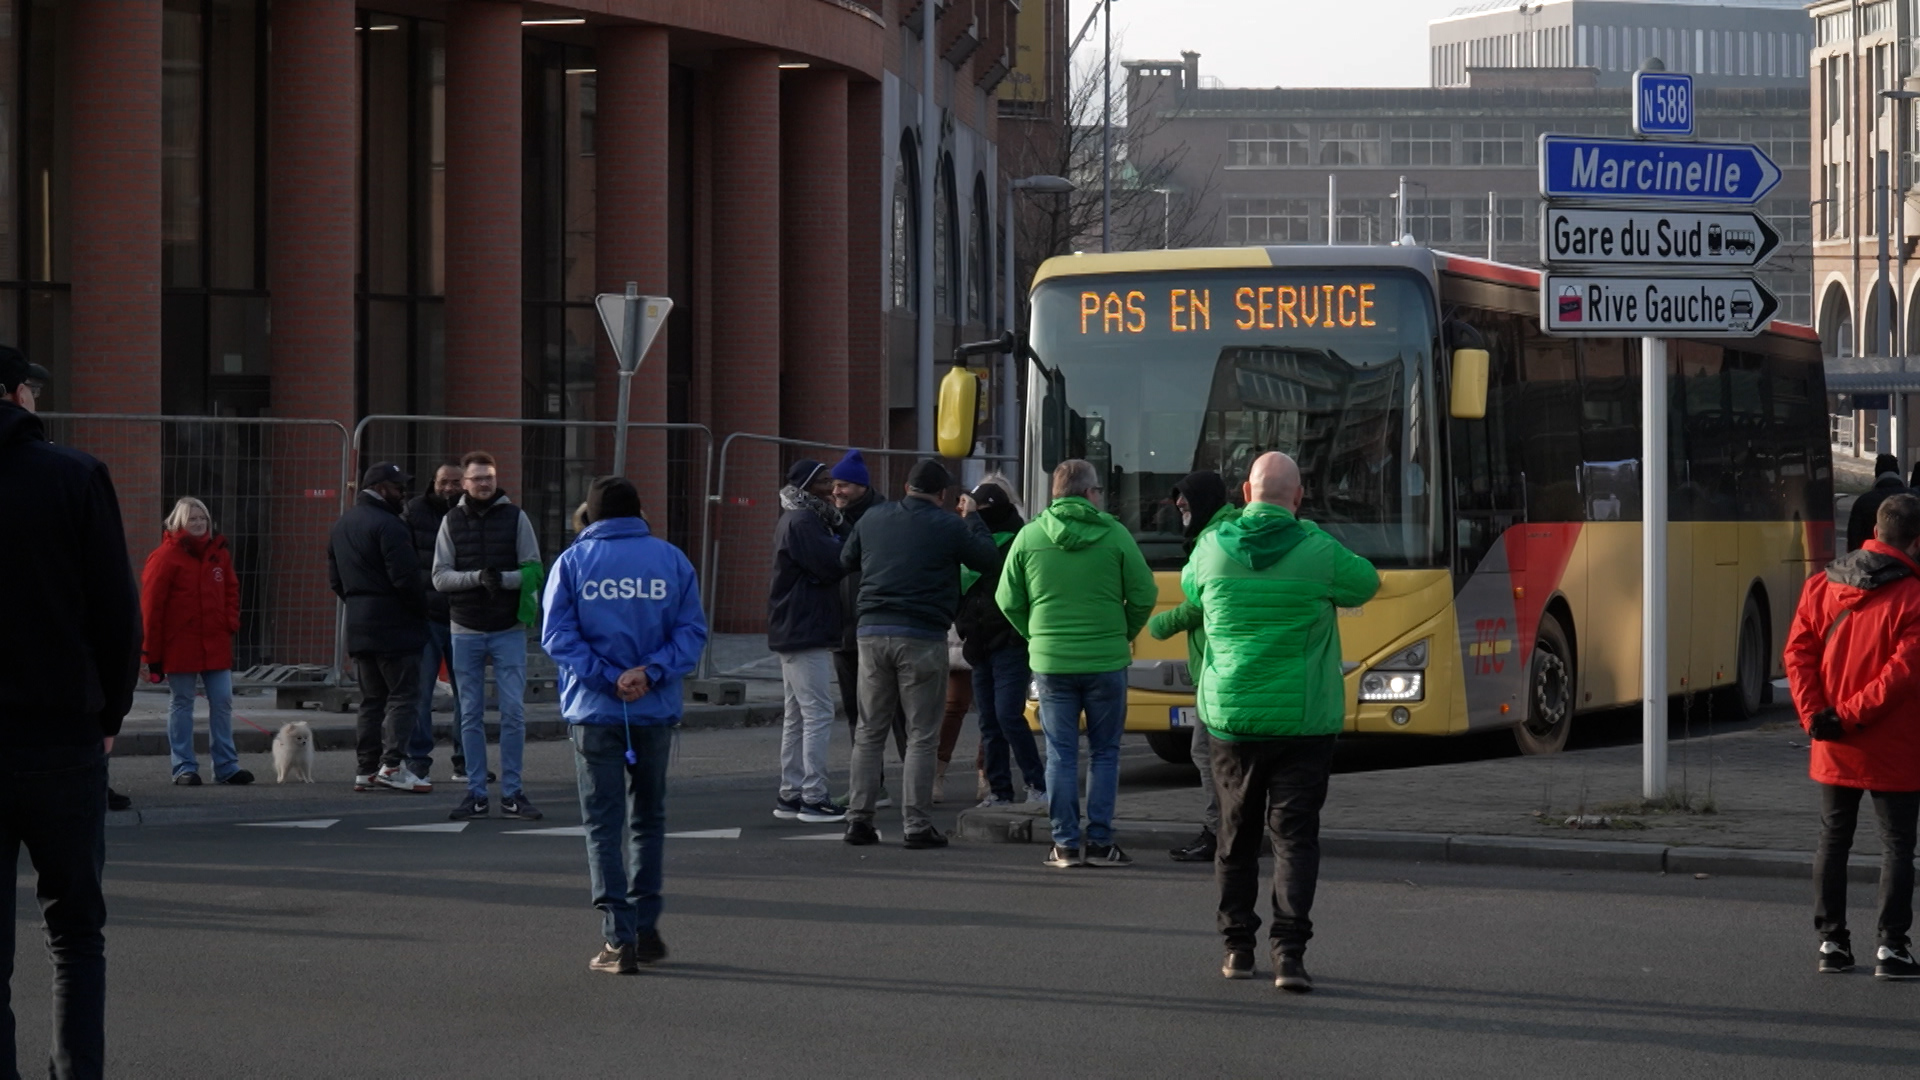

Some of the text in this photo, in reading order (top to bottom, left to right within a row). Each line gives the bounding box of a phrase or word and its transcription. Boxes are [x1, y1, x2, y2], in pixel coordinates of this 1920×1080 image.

[1571, 147, 1741, 193] Marcinelle
[1554, 215, 1702, 257] Gare du Sud
[1081, 283, 1377, 334] PAS EN SERVICE
[1588, 283, 1726, 323] Rive Gauche
[582, 577, 667, 600] CGSLB
[1475, 617, 1507, 675] TEC
